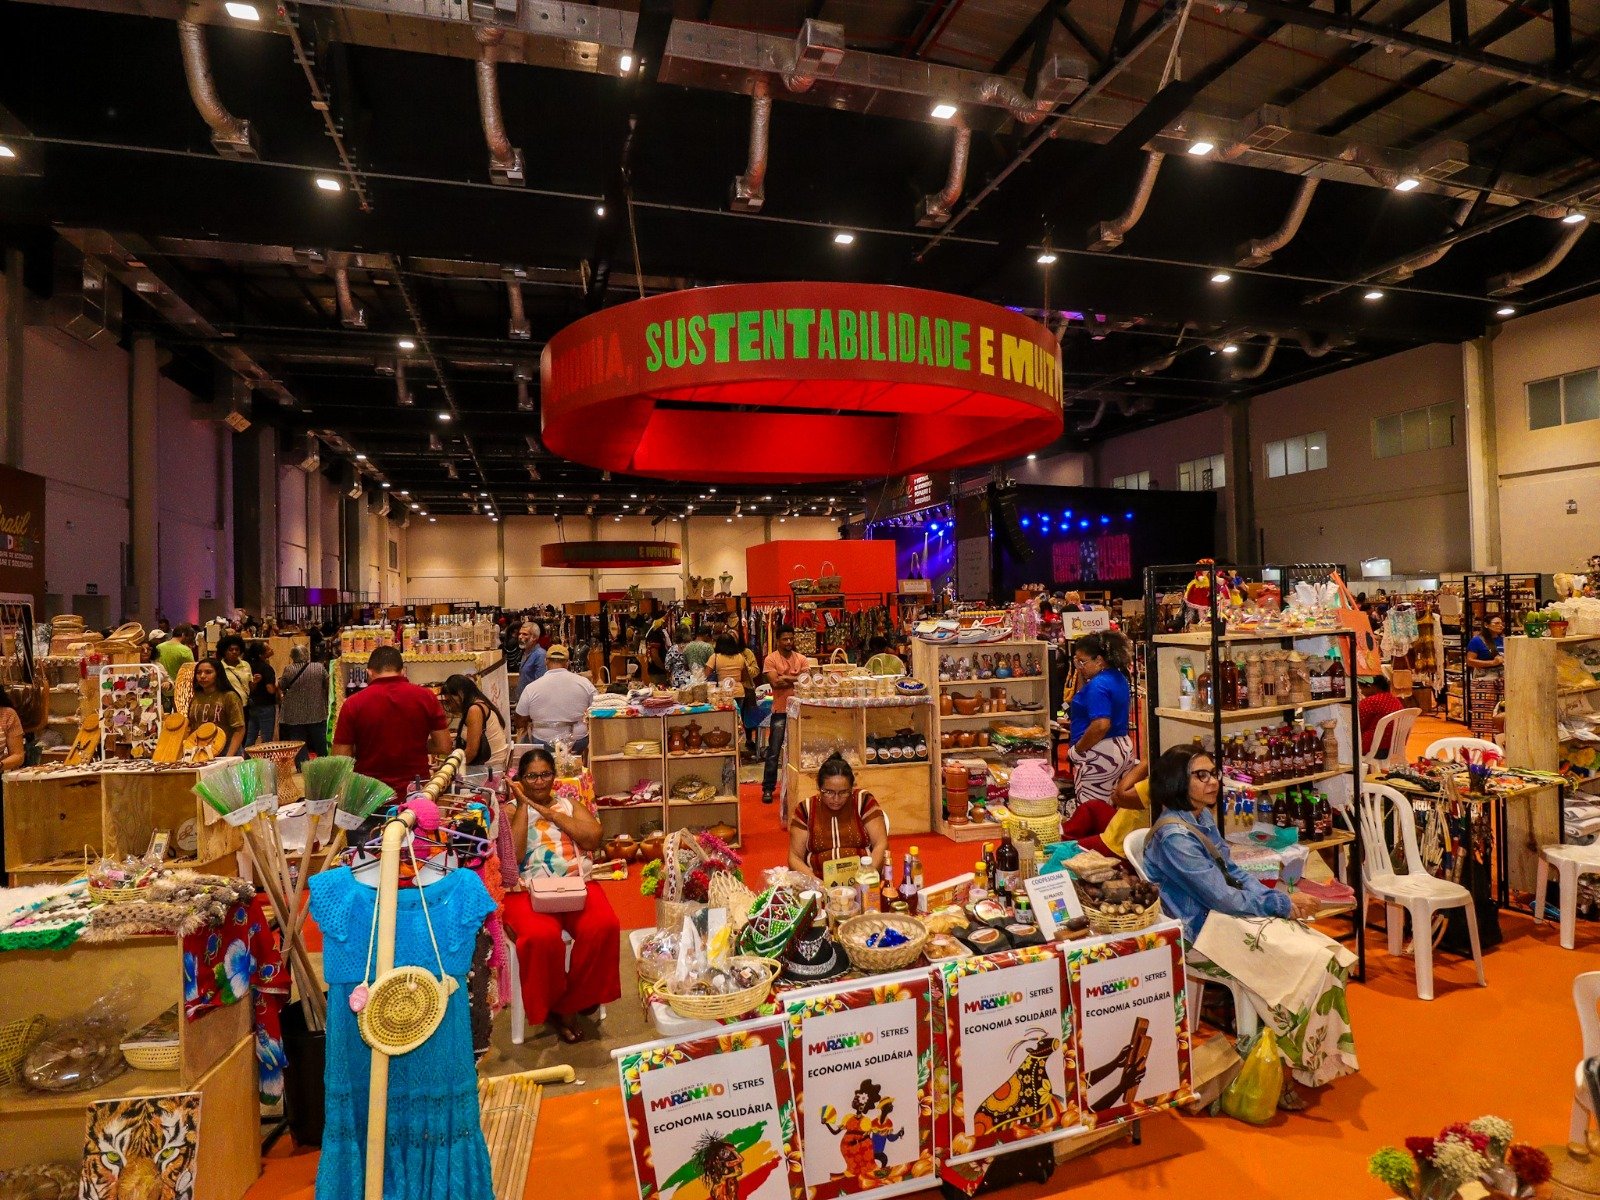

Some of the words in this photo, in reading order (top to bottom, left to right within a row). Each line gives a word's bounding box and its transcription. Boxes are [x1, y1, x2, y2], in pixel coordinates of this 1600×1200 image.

[645, 308, 971, 372] SUSTENTABILIDADE
[980, 326, 995, 376] E
[1002, 333, 1059, 402] MUIT
[0, 504, 31, 535] rasil
[1144, 970, 1167, 982] SETRES
[1029, 986, 1054, 998] SETRES
[1086, 1002, 1130, 1017] ECONOMIA
[1132, 991, 1171, 1007] SOLIDÁRIA
[880, 1027, 909, 1038] SETRES
[964, 1019, 1012, 1035] ECONOMIA
[1015, 1008, 1057, 1024] SOLIDÁRIA
[808, 1060, 861, 1078] ECONOMIA
[865, 1050, 913, 1066] SOLIDÁRIA
[732, 1077, 765, 1091] SETRES
[653, 1112, 713, 1134] ECONOMIA
[716, 1102, 773, 1119] SOLIDÁRIA
